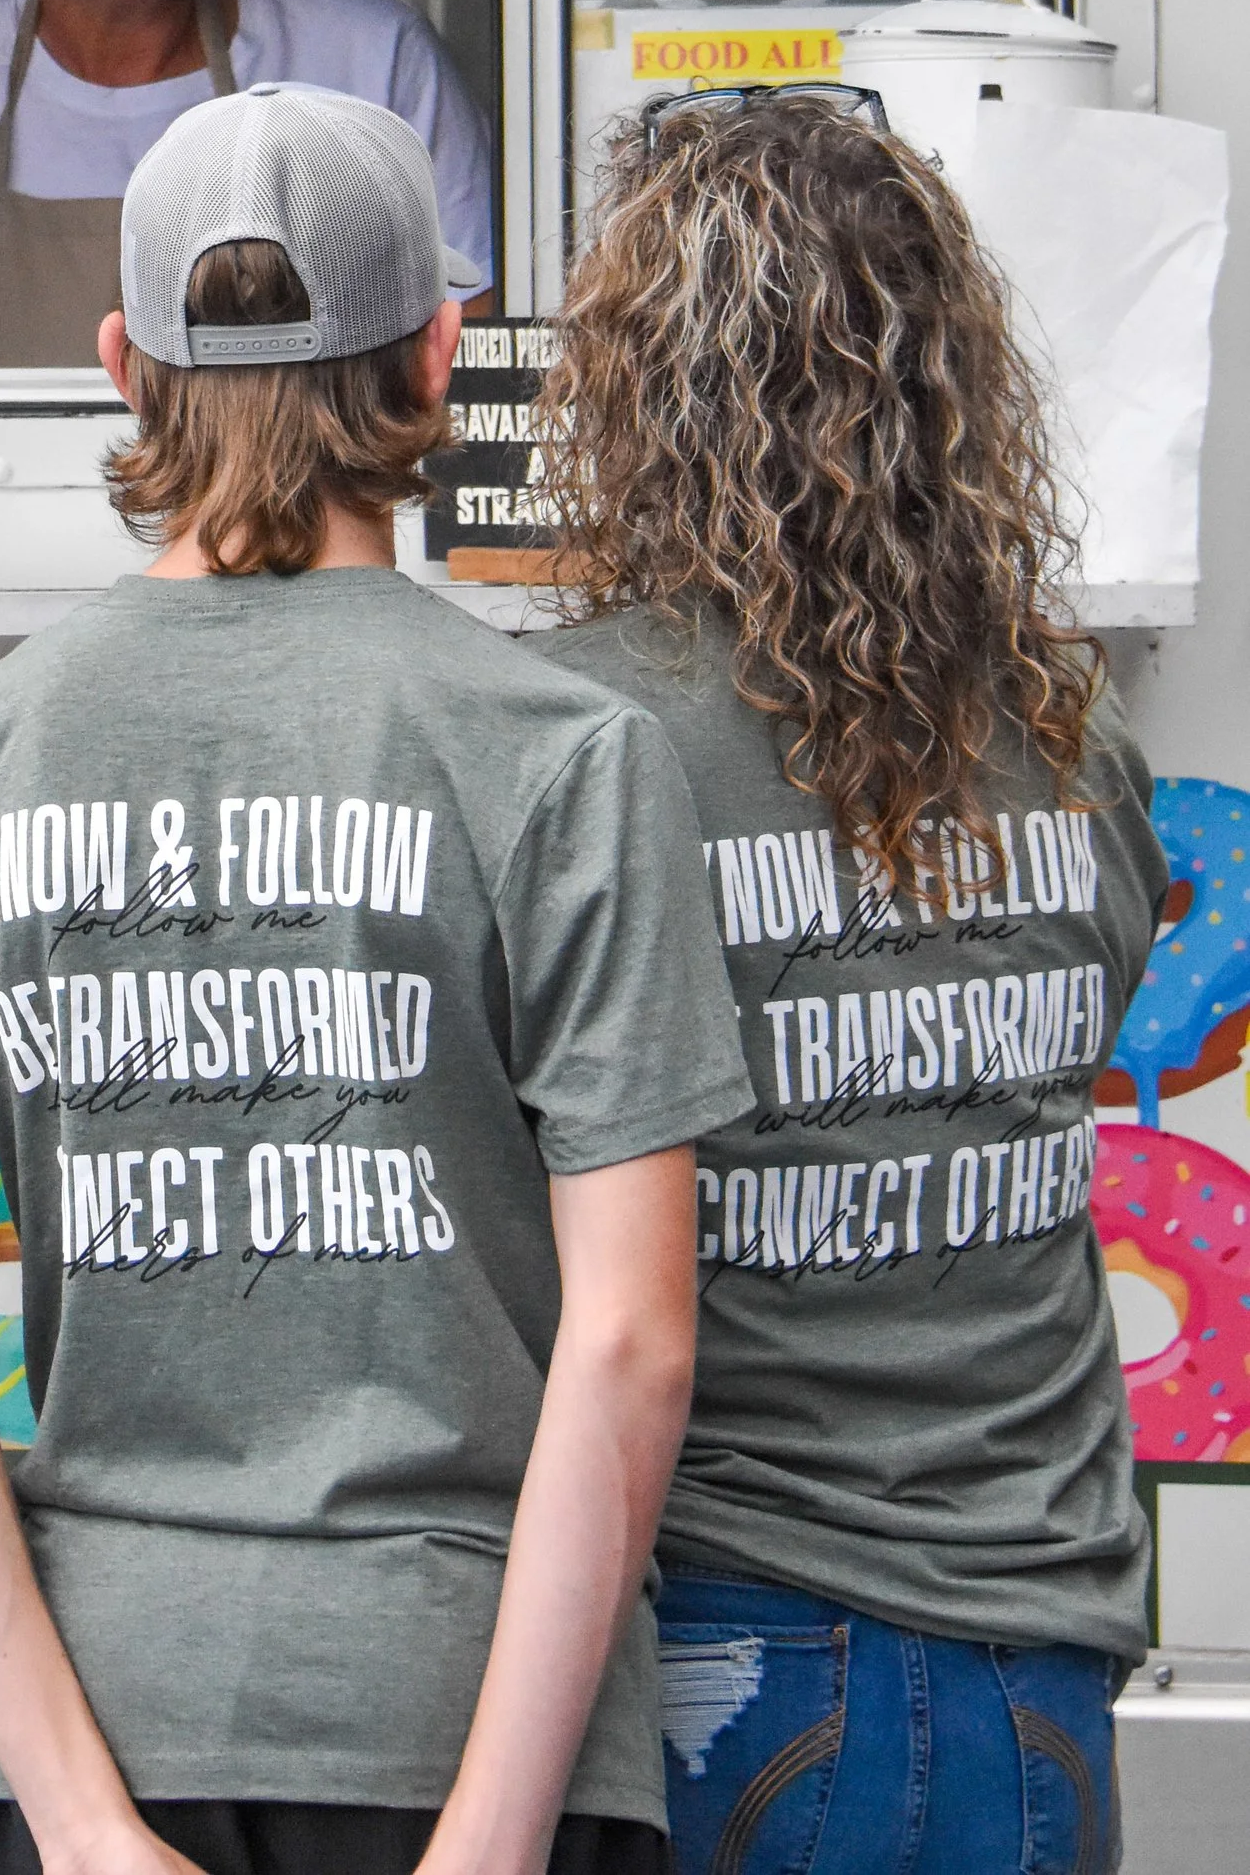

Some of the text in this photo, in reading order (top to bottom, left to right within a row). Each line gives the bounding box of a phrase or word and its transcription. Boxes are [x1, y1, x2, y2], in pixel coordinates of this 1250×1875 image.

[634, 41, 750, 71] FOOD
[149, 799, 197, 908] &
[219, 795, 434, 917] FOLLOW
[702, 829, 842, 947] NOW
[47, 862, 327, 966] follow me
[768, 885, 1024, 999] follow me
[169, 1034, 322, 1116] make
[302, 1083, 410, 1145] you
[753, 1053, 895, 1136] will
[884, 1040, 1020, 1123] make
[762, 963, 1104, 1105] TRANSFORMED
[56, 1142, 455, 1264] NECT OTHERS
[696, 1153, 932, 1268] CONNECT
